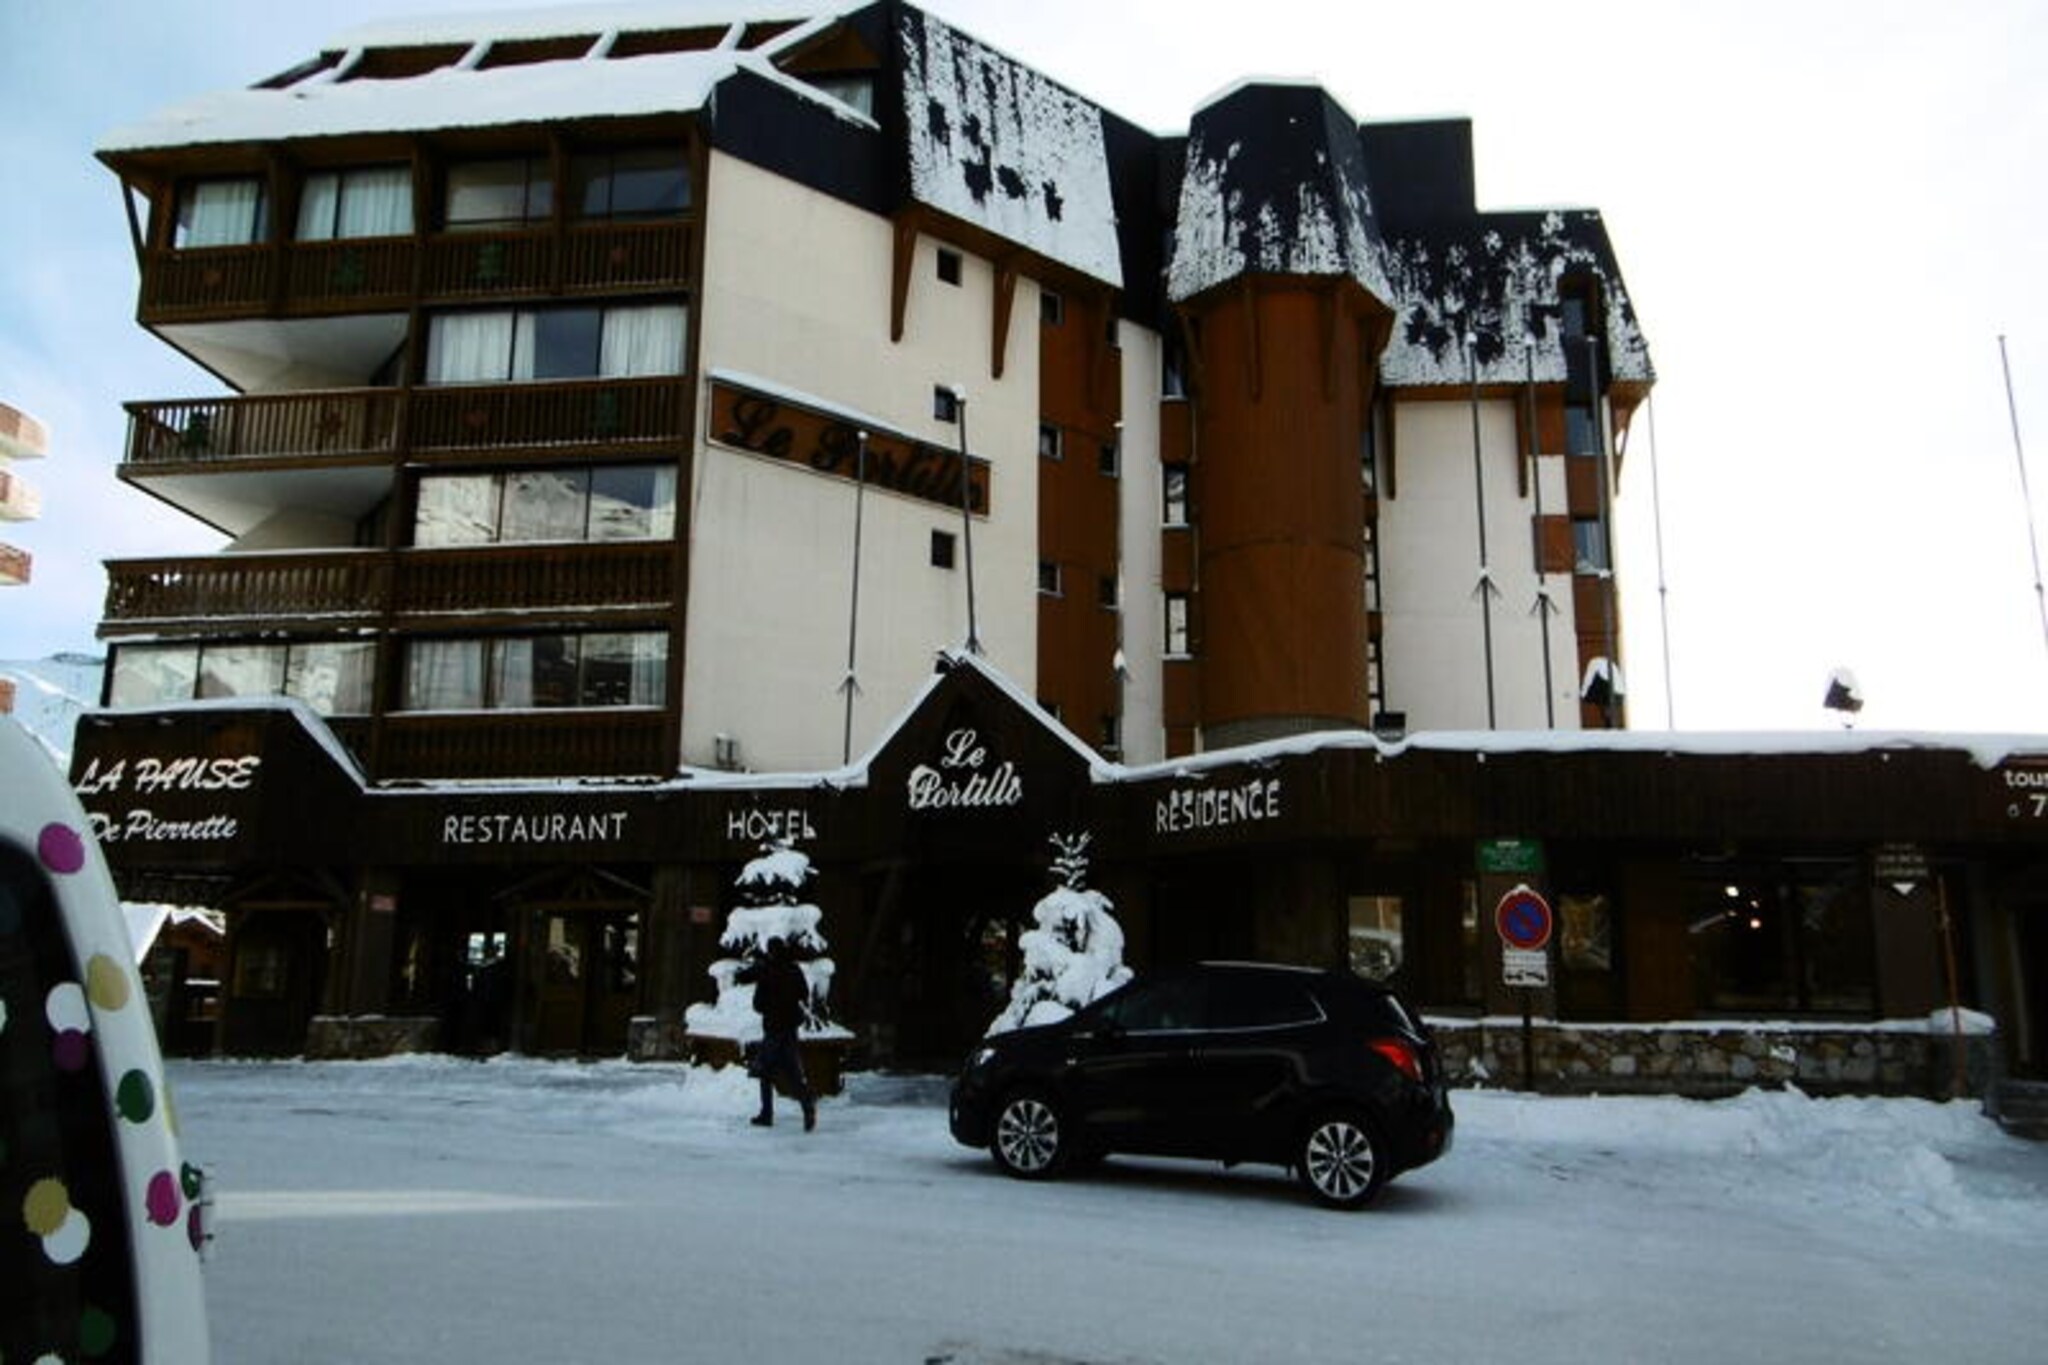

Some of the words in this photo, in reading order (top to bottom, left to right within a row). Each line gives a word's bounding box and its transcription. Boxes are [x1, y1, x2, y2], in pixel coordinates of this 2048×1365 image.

[941, 728, 987, 768] Le
[75, 757, 127, 794] LA
[135, 755, 261, 794] PAUSE
[88, 811, 121, 842] De
[123, 809, 237, 841] Pierrette
[443, 812, 628, 843] RESTAURANT
